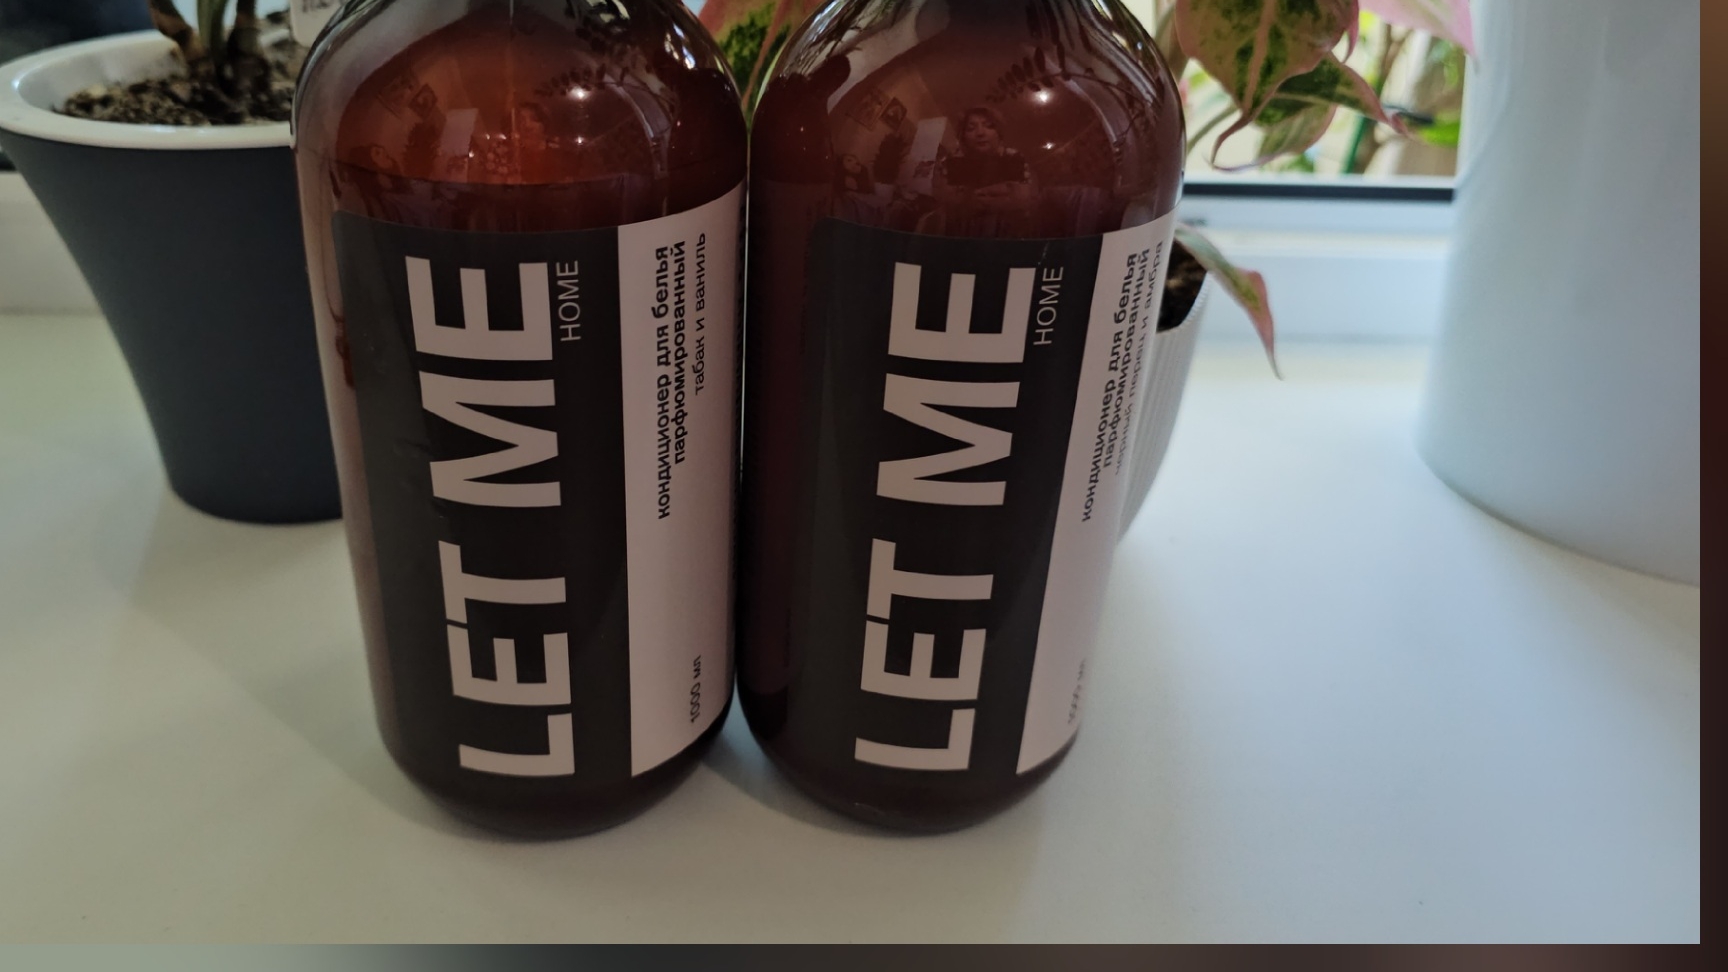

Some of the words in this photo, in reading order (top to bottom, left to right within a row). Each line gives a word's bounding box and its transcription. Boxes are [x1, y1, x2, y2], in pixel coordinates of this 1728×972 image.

[555, 260, 581, 344] HOME
[650, 245, 668, 318] белья
[694, 232, 706, 310] ваниль
[1032, 265, 1065, 347] HOME
[1113, 251, 1138, 323] белья
[656, 324, 669, 366] для
[670, 240, 688, 464] парфюмированный
[696, 317, 705, 329] и
[1101, 247, 1149, 466] парфюмированный
[1107, 329, 1123, 372] для
[405, 255, 561, 508] ME
[693, 335, 705, 395] табак
[876, 261, 1036, 506] ME
[656, 373, 670, 519] кондиционер
[1080, 379, 1119, 521] кондиционер
[439, 540, 575, 777] LET
[855, 538, 995, 771] LET
[690, 681, 700, 723] 1000
